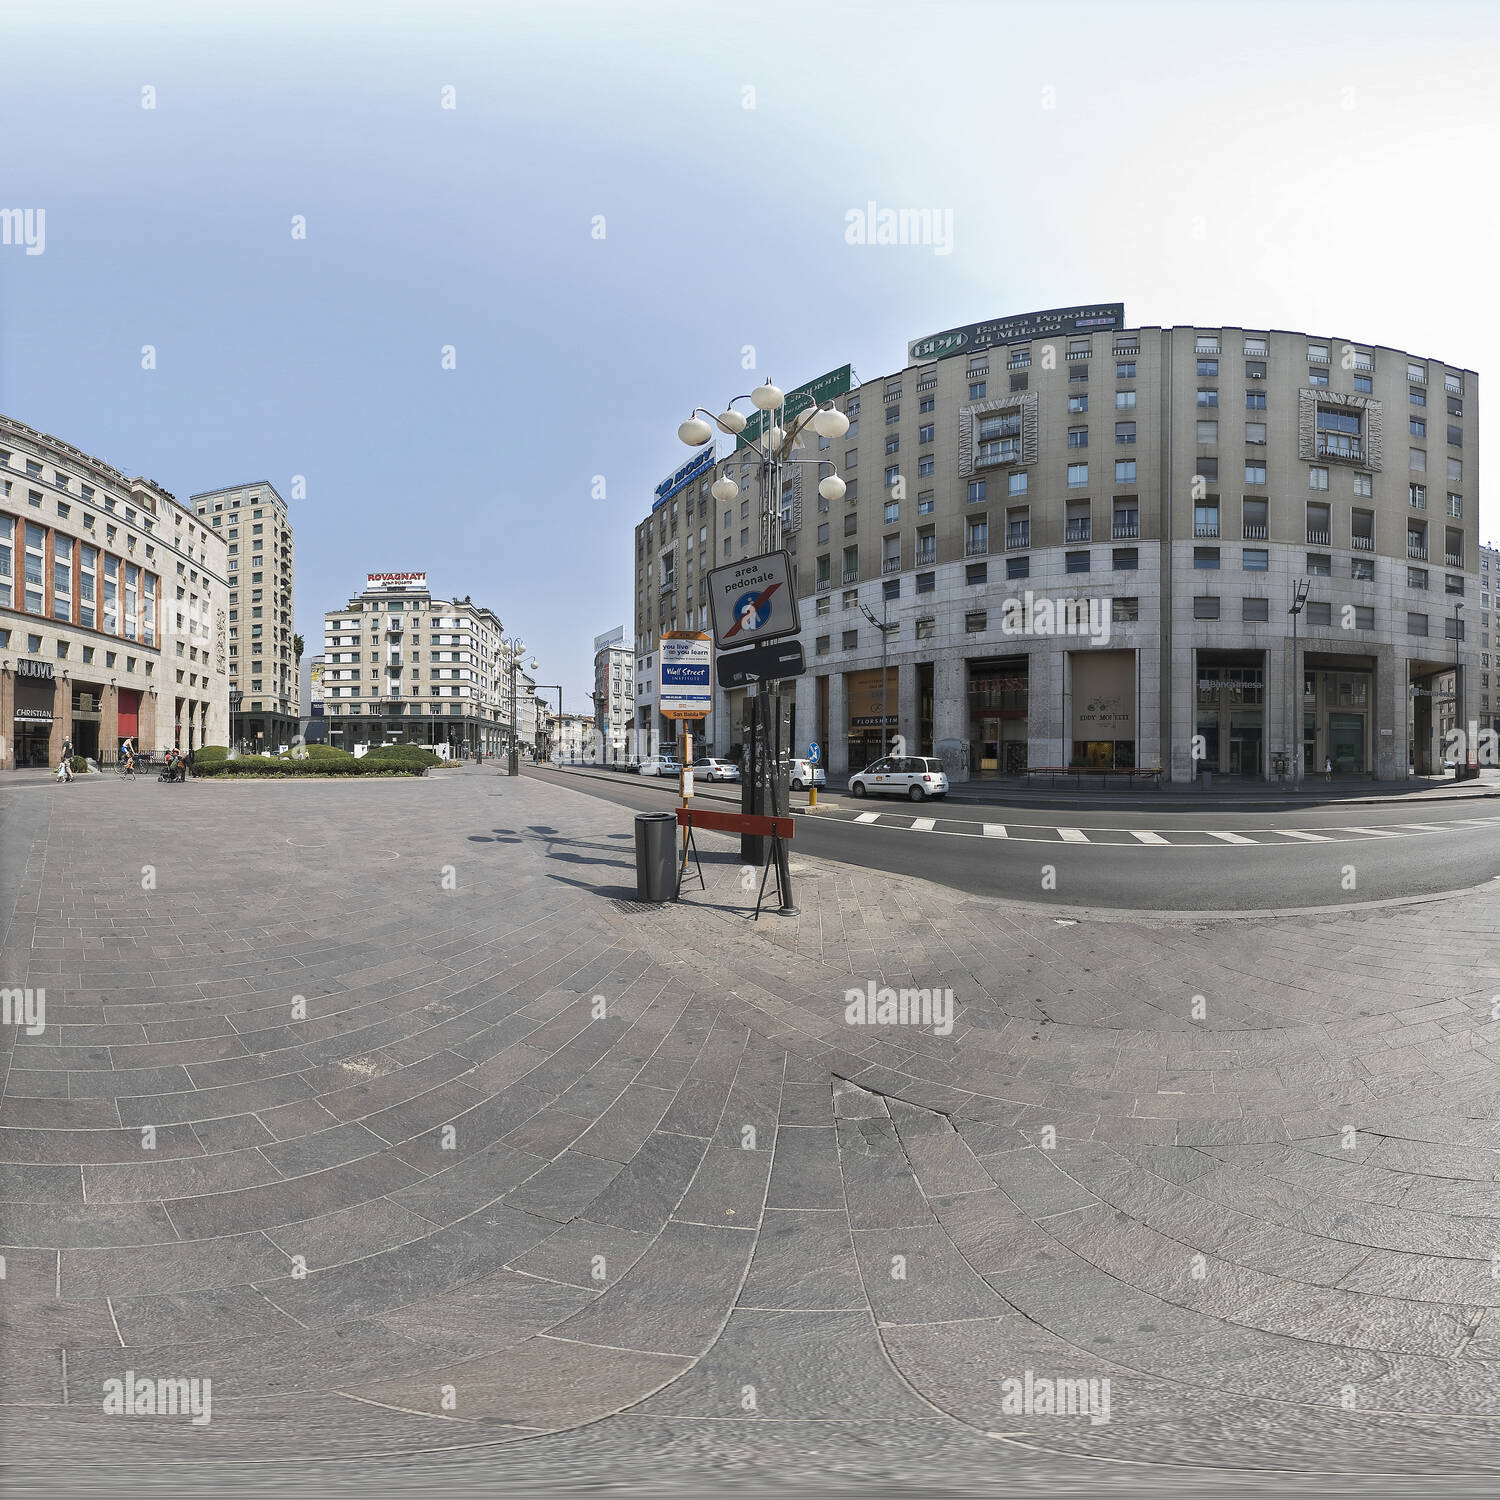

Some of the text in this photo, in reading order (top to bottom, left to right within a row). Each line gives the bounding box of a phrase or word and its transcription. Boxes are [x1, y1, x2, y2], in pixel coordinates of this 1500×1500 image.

[976, 320, 1029, 335] Banca
[1036, 309, 1118, 324] Popolare
[975, 323, 1061, 344] di Milano
[913, 332, 963, 357] BPM
[674, 446, 713, 484] MOBY
[367, 572, 426, 581] ROVAGNATI
[735, 564, 759, 578] area
[725, 572, 774, 593] pedonale
[18, 659, 54, 679] NUOVO
[666, 667, 705, 676] Wall Street
[16, 709, 52, 718] CHRISTIAN
